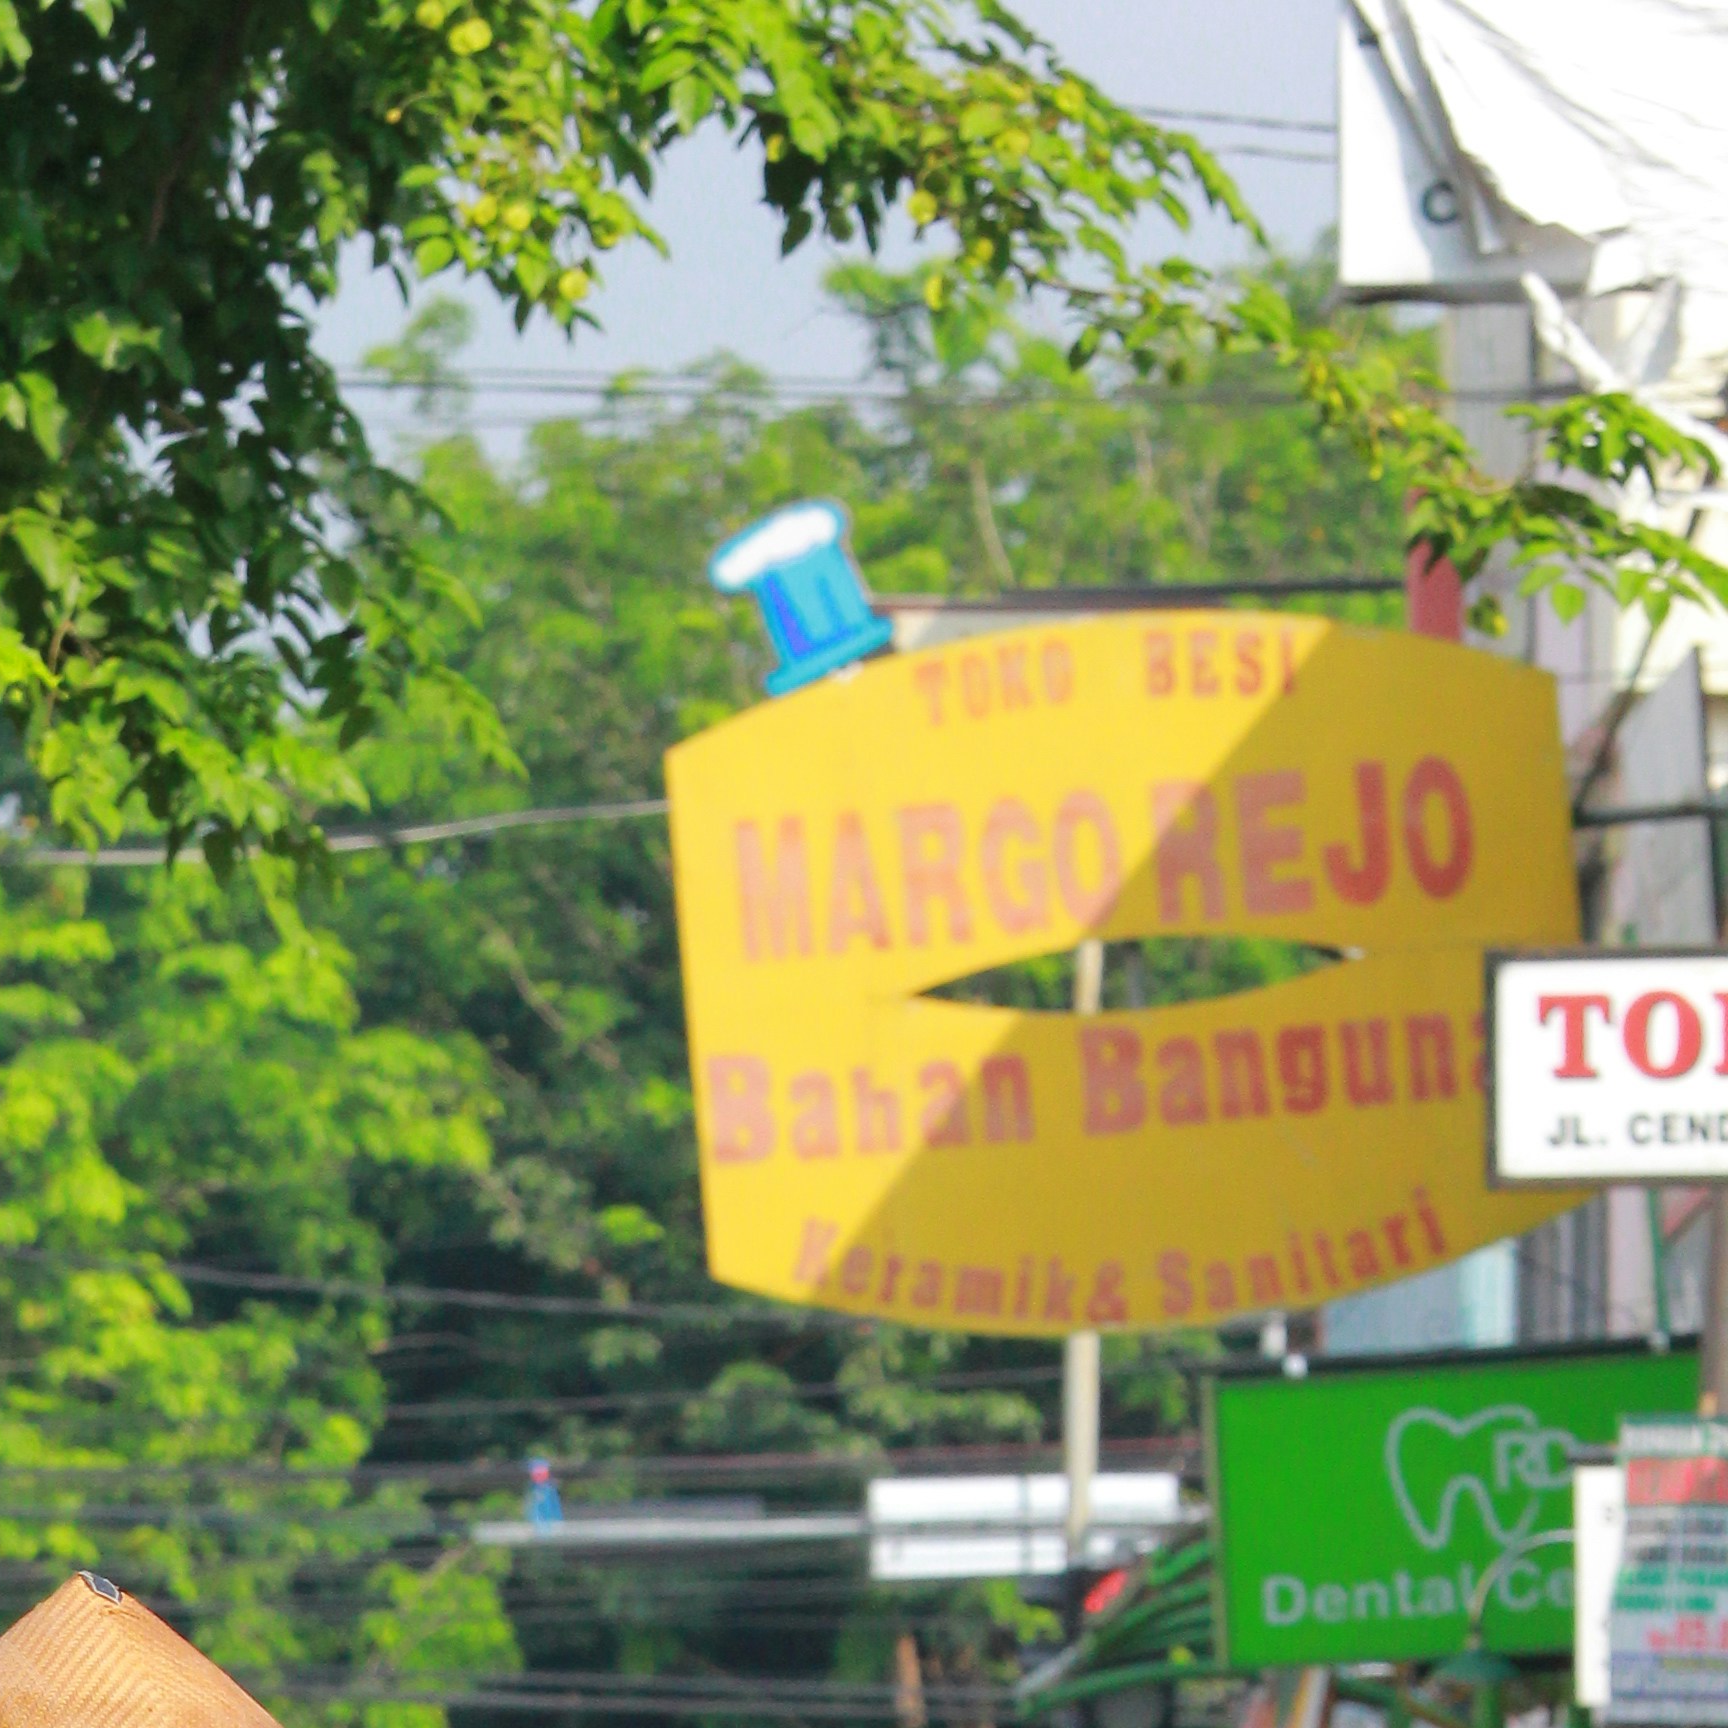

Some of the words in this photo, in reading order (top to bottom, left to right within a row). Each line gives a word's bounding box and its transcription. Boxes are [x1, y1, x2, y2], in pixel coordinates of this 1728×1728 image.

[913, 638, 1073, 728] TOKO
[1144, 627, 1297, 700] BESI
[732, 786, 1123, 964] MARGO
[1147, 753, 1472, 925] REJO
[705, 1051, 1036, 1165] Bahan
[1079, 1013, 1485, 1137] Bangun
[1154, 1180, 1450, 1317] Sanitari
[1261, 1562, 1476, 1627] Dental
